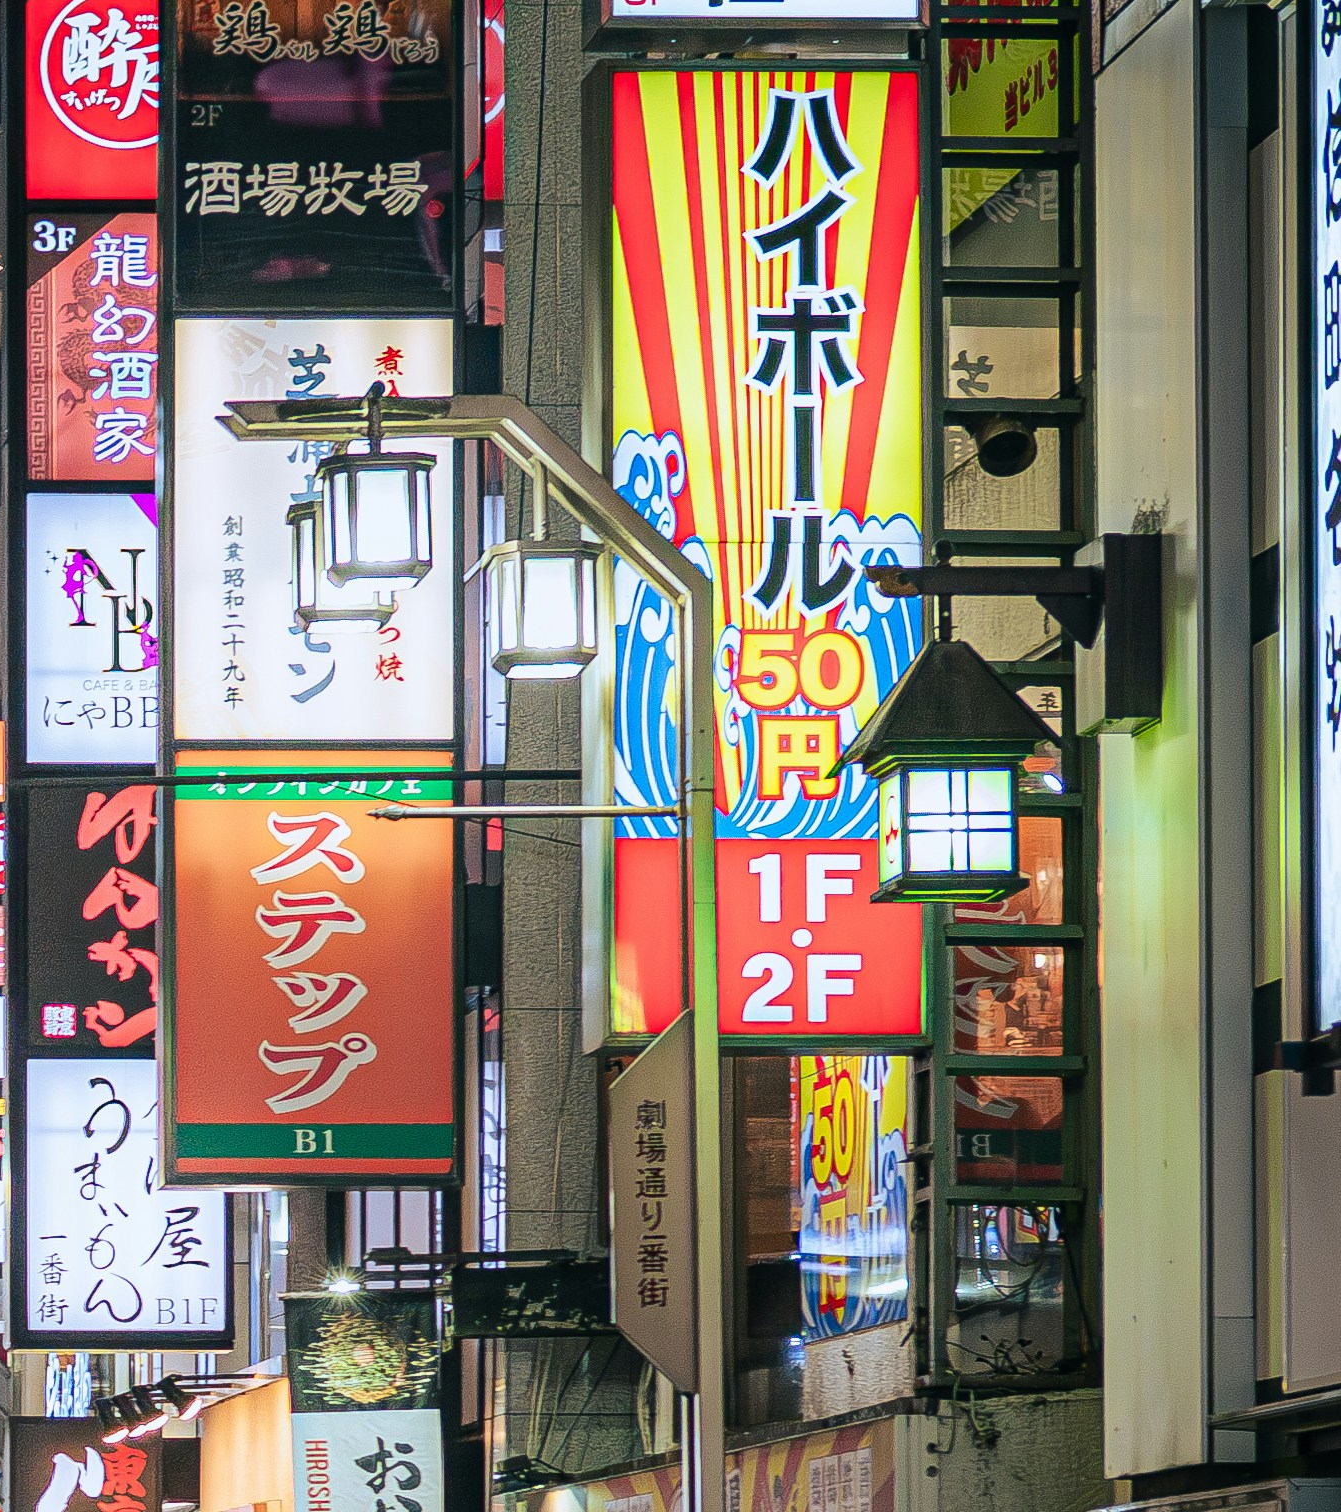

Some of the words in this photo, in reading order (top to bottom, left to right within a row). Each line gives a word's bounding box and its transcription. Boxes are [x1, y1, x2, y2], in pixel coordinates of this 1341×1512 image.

[61, 86, 123, 114] すいげつ
[190, 104, 224, 129] 2F
[185, 160, 430, 217] 酒場牧場
[33, 221, 77, 252] 3F
[90, 232, 159, 464] 龍幻酒家
[744, 88, 857, 617] ハイボール
[222, 515, 247, 711] 創業昭和二十九年
[748, 853, 862, 925] 1F
[249, 810, 377, 1115] ステップ
[740, 953, 864, 1024] 2F
[292, 1129, 337, 1155] B1
[74, 1076, 145, 1324] うまいもん
[633, 1098, 670, 1311] 劇場通り一番街
[37, 1235, 68, 1326] 一番街
[156, 1297, 219, 1326] B1F
